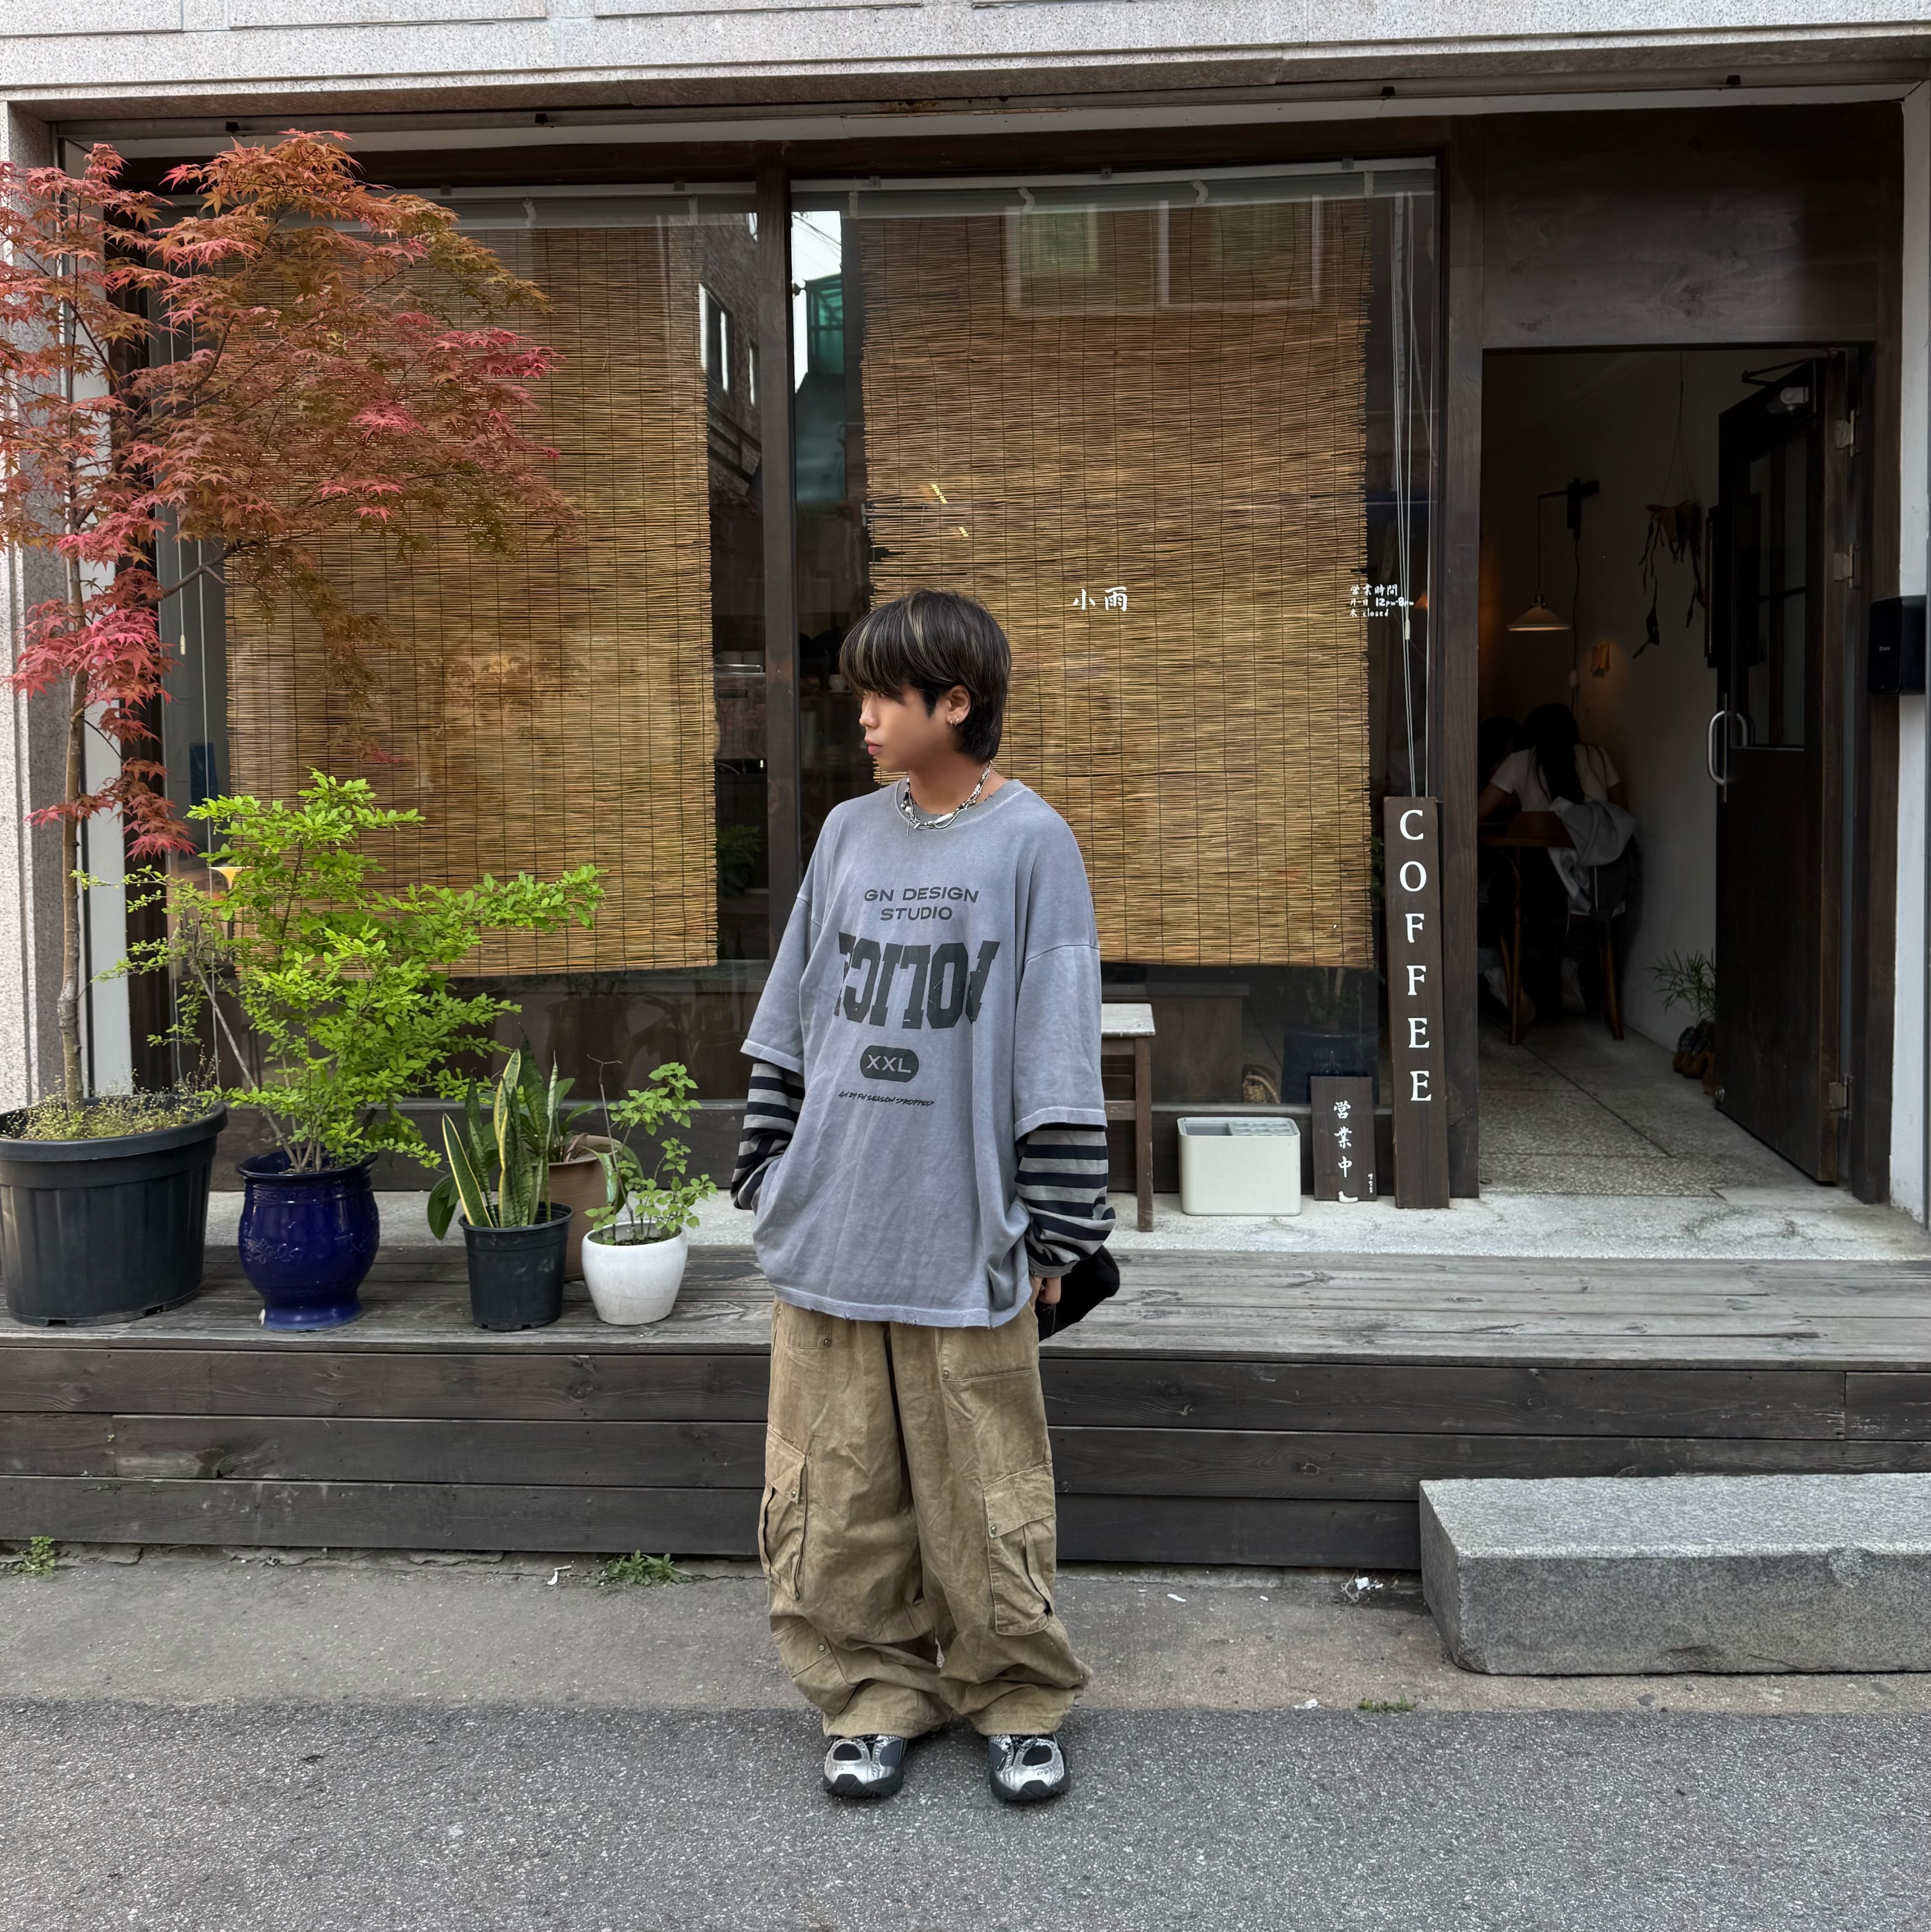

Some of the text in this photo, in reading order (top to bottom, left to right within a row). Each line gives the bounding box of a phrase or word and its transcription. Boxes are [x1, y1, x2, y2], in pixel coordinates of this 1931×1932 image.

[1072, 586, 1128, 612] 小雨
[1362, 608, 1389, 617] closed
[864, 886, 979, 903] GN DESIGN
[880, 906, 953, 921] STUDIO
[1399, 810, 1431, 1101] COFFEE
[865, 1054, 912, 1073] XXL
[1334, 1100, 1352, 1178] 営業中
